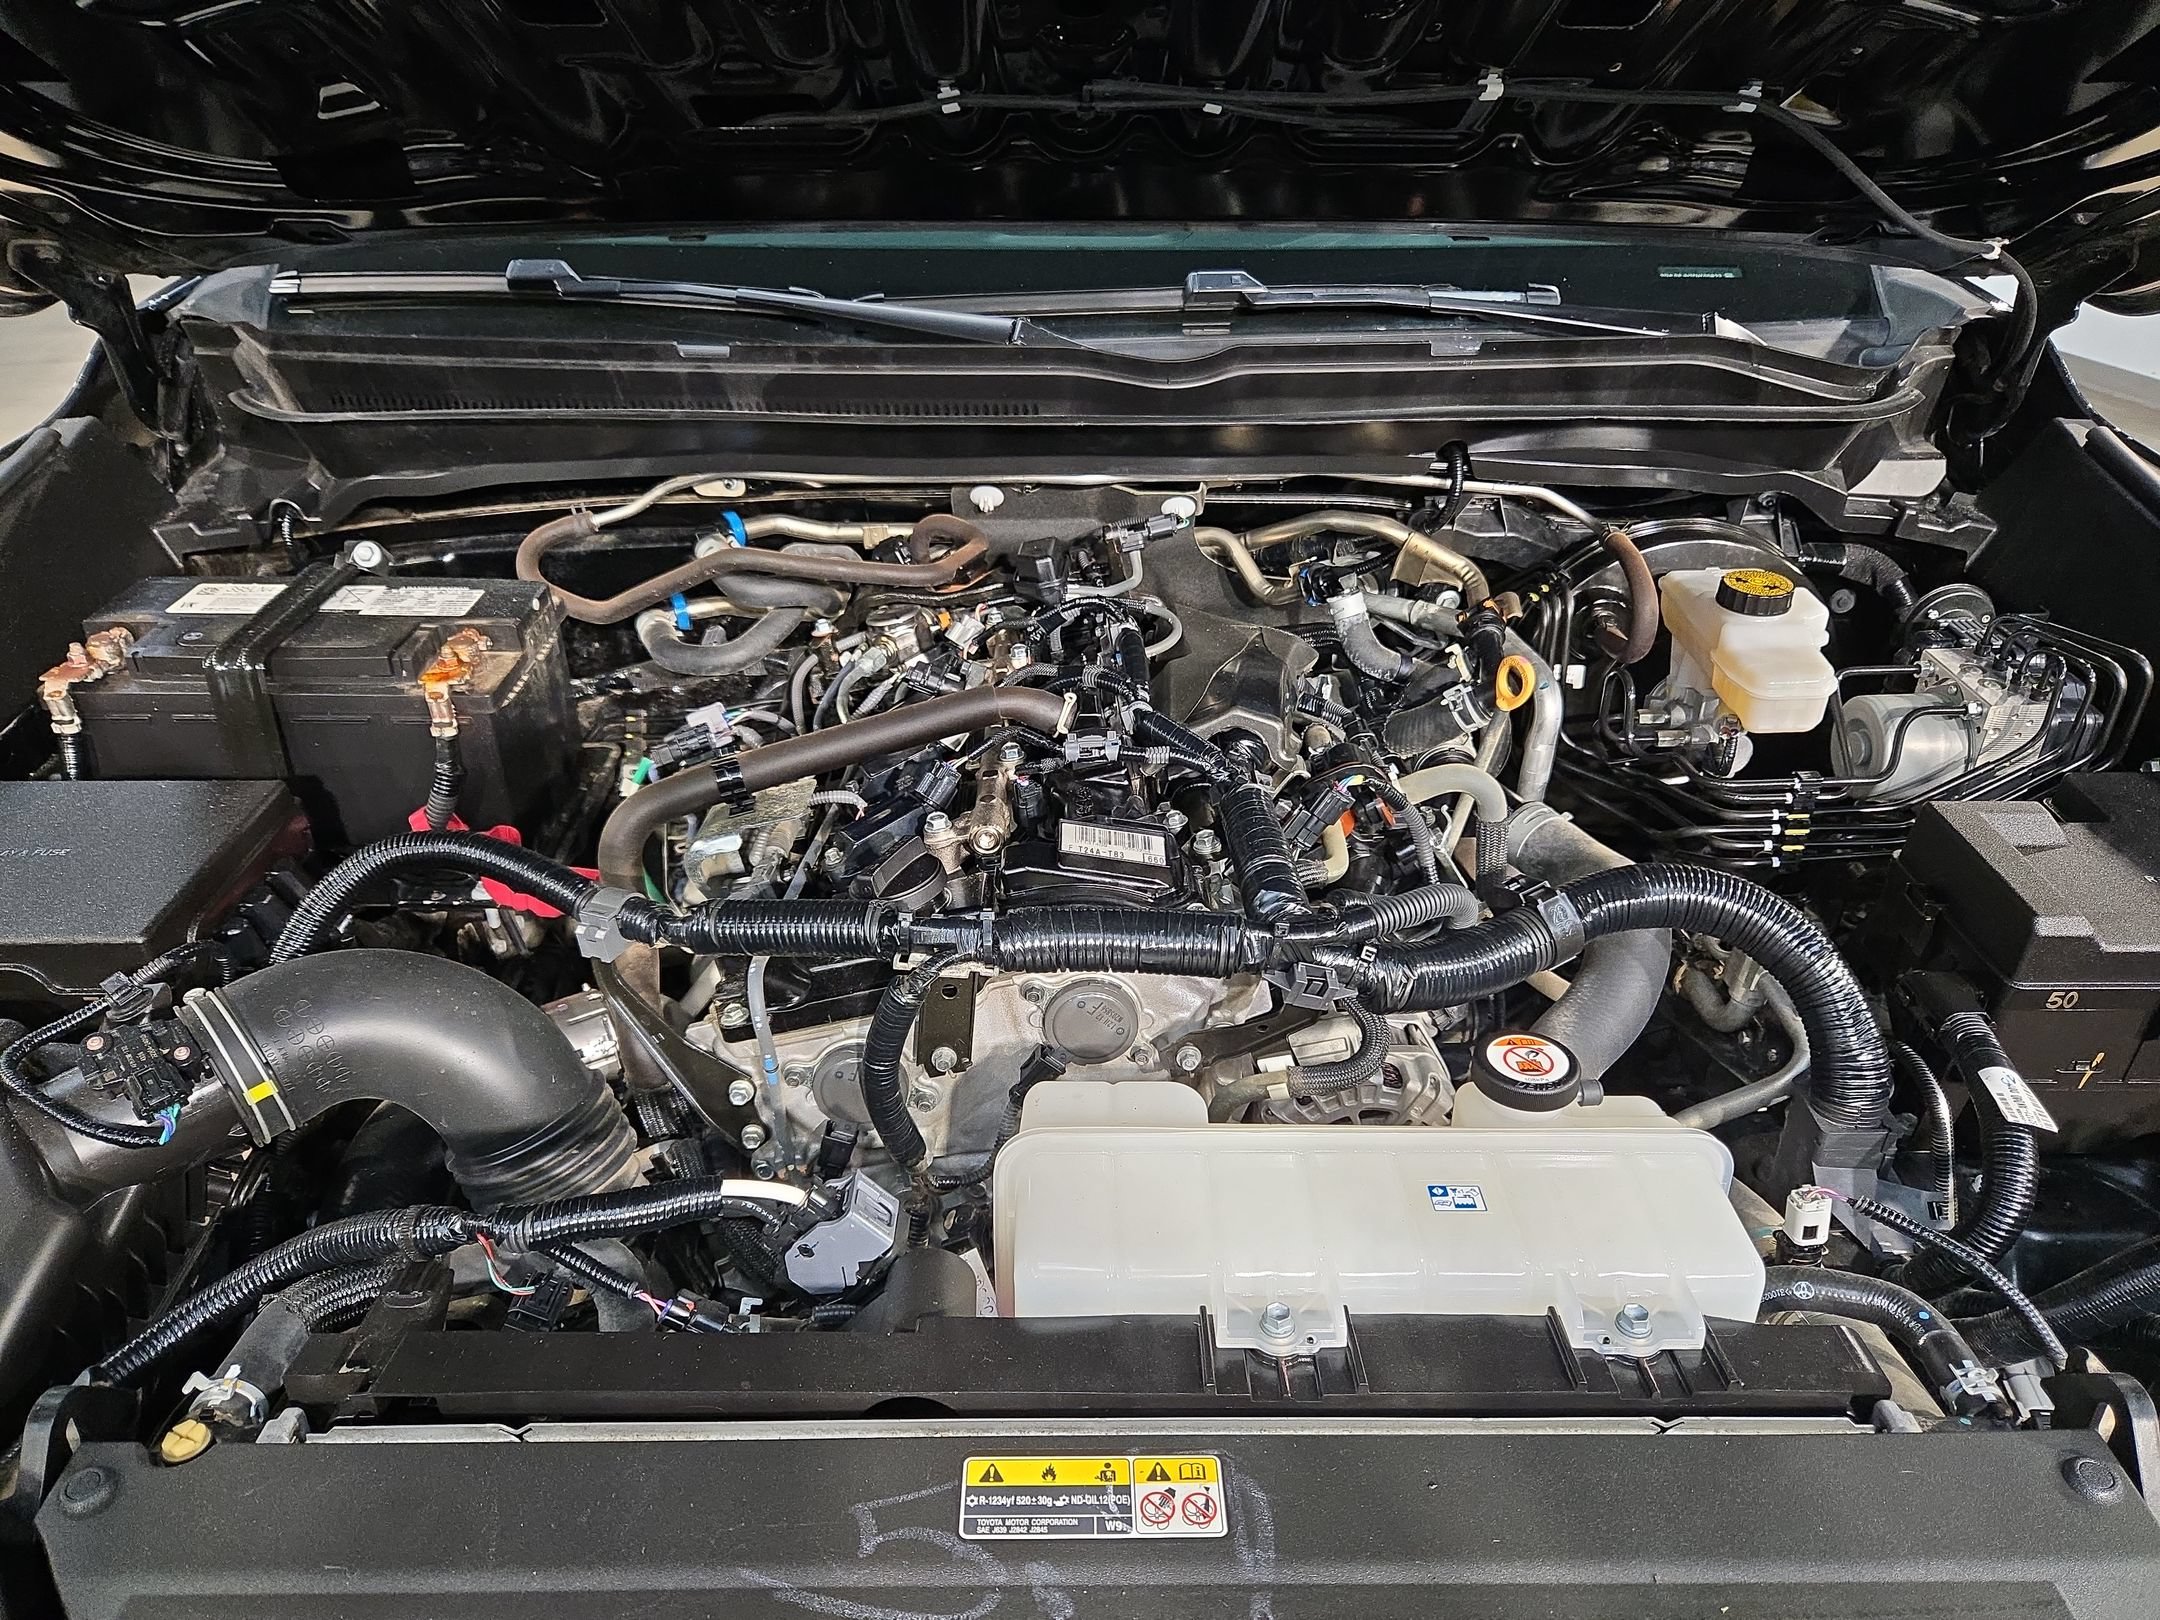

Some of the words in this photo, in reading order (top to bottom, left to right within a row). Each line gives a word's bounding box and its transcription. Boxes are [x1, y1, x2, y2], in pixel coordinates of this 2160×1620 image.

[31, 847, 71, 857] FUSE
[2045, 991, 2080, 1009] 50
[979, 1495, 1015, 1508] R-1234yf
[1015, 1495, 1053, 1508] 520±30g
[976, 1526, 991, 1534] SAE
